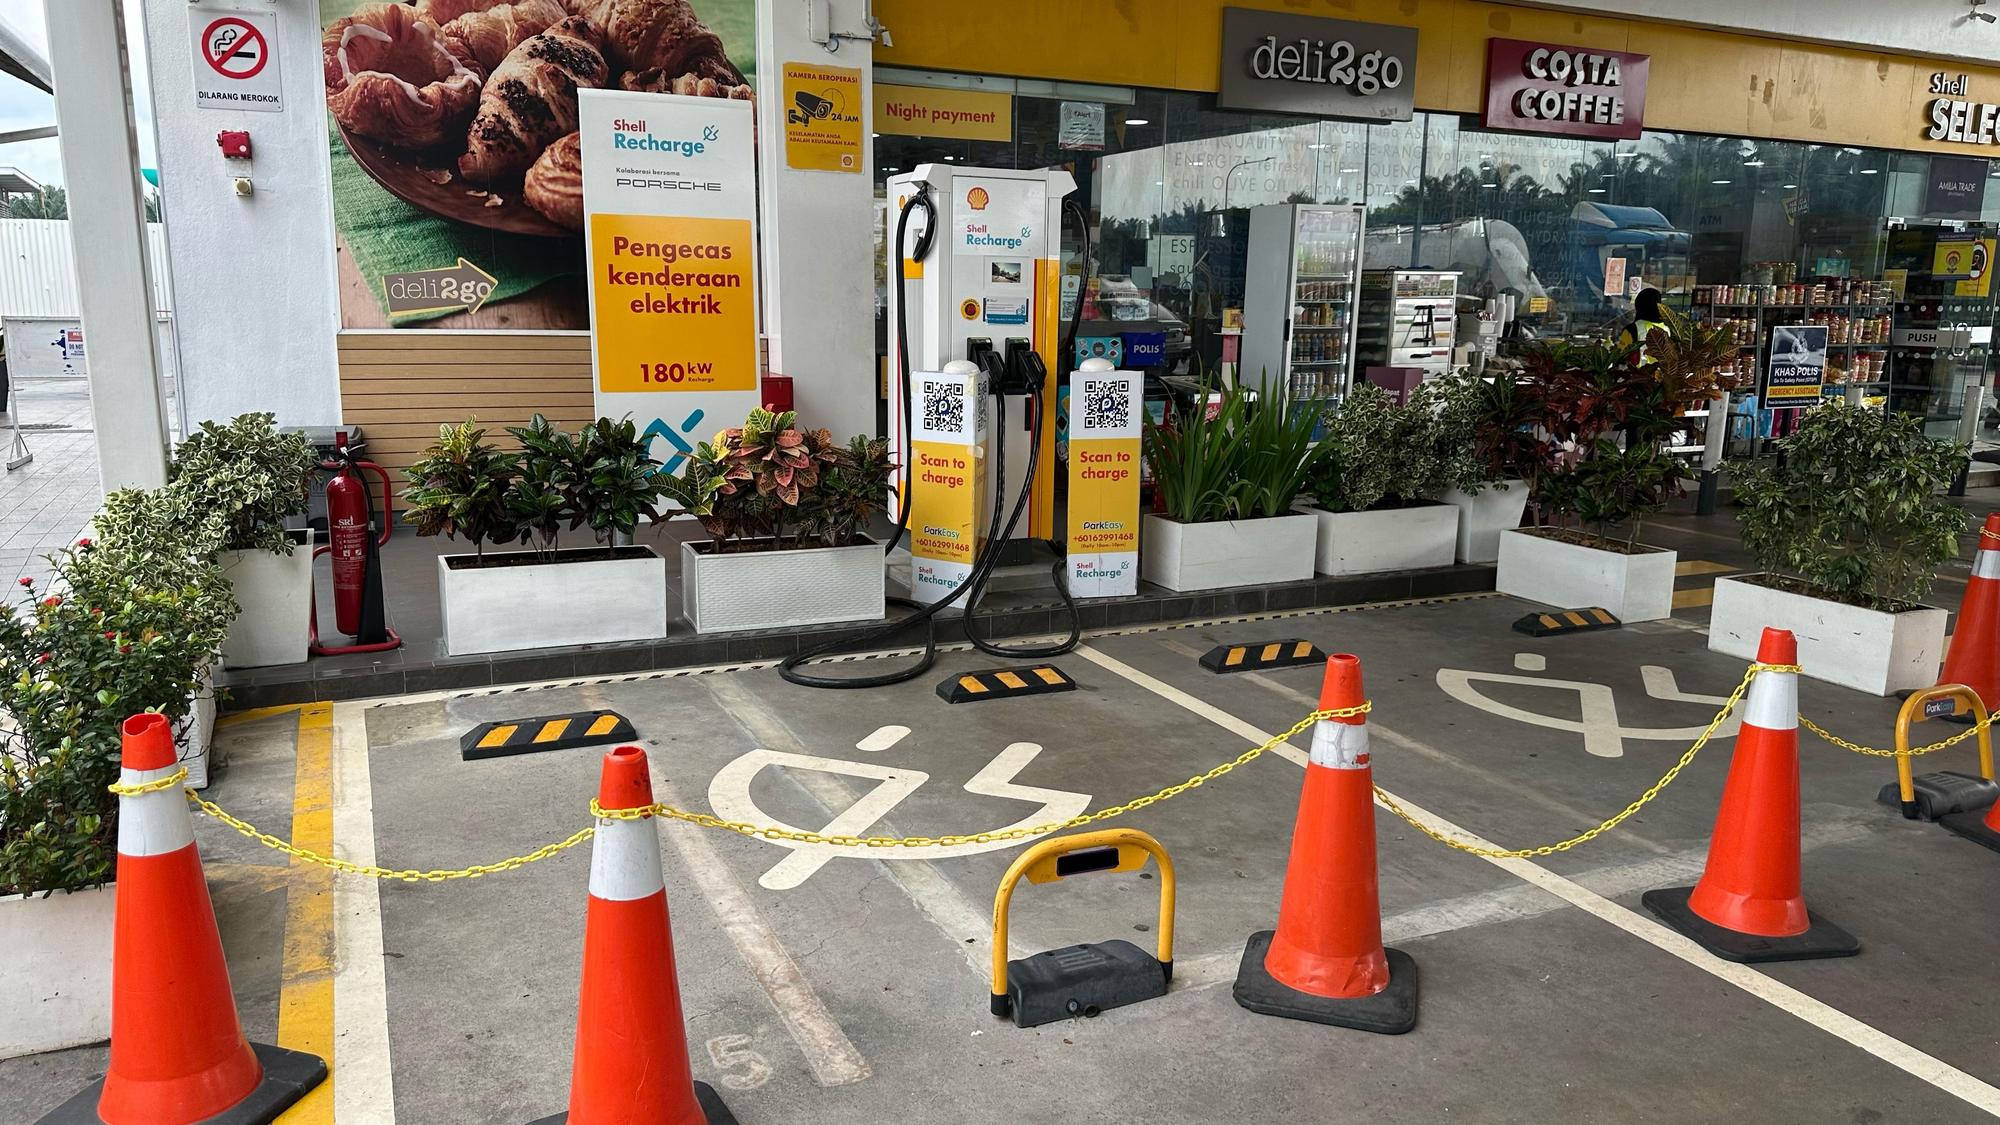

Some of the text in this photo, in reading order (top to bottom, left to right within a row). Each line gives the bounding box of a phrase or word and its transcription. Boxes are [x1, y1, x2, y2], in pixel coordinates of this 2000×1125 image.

[1253, 36, 1403, 95] deli2go
[1529, 47, 1621, 86] COSTA
[788, 71, 858, 83] KAMERA BEROPERASI
[1932, 73, 1969, 96] Shell
[198, 91, 280, 103] DILARANG MEROKOK
[1520, 87, 1625, 125] COFFEE
[831, 112, 860, 123] 24 JAM
[885, 103, 996, 125] Night payment
[613, 119, 646, 132] Shell
[614, 133, 705, 157] Recharge
[616, 178, 722, 192] PORSCHE
[1959, 182, 1976, 192] TRADE
[1699, 215, 1722, 225] ATM
[966, 224, 987, 233] Shell
[966, 234, 1022, 249] Recharge
[613, 236, 732, 264] Pengecas
[608, 264, 741, 287] kenderaan
[390, 277, 492, 304] deli2go
[630, 292, 722, 314] elektrik
[1907, 333, 1937, 343] PUSH
[640, 362, 713, 383] 180 kW
[1774, 366, 1819, 377] KHAS POLIS
[688, 376, 715, 384] Recharge
[920, 453, 966, 469] Scan to
[1080, 451, 1130, 463] Scan to
[921, 470, 964, 488] charge
[1081, 467, 1129, 481] charge
[924, 526, 960, 540] ParkEasy
[1083, 521, 1124, 531] ParkEasy
[1073, 532, 1134, 543] +60162991468
[916, 538, 970, 553] +60162991468
[918, 566, 933, 575] Shell
[1076, 568, 1122, 579] Recharge
[918, 574, 959, 589] Recharge
[706, 1033, 773, 1090] 5
